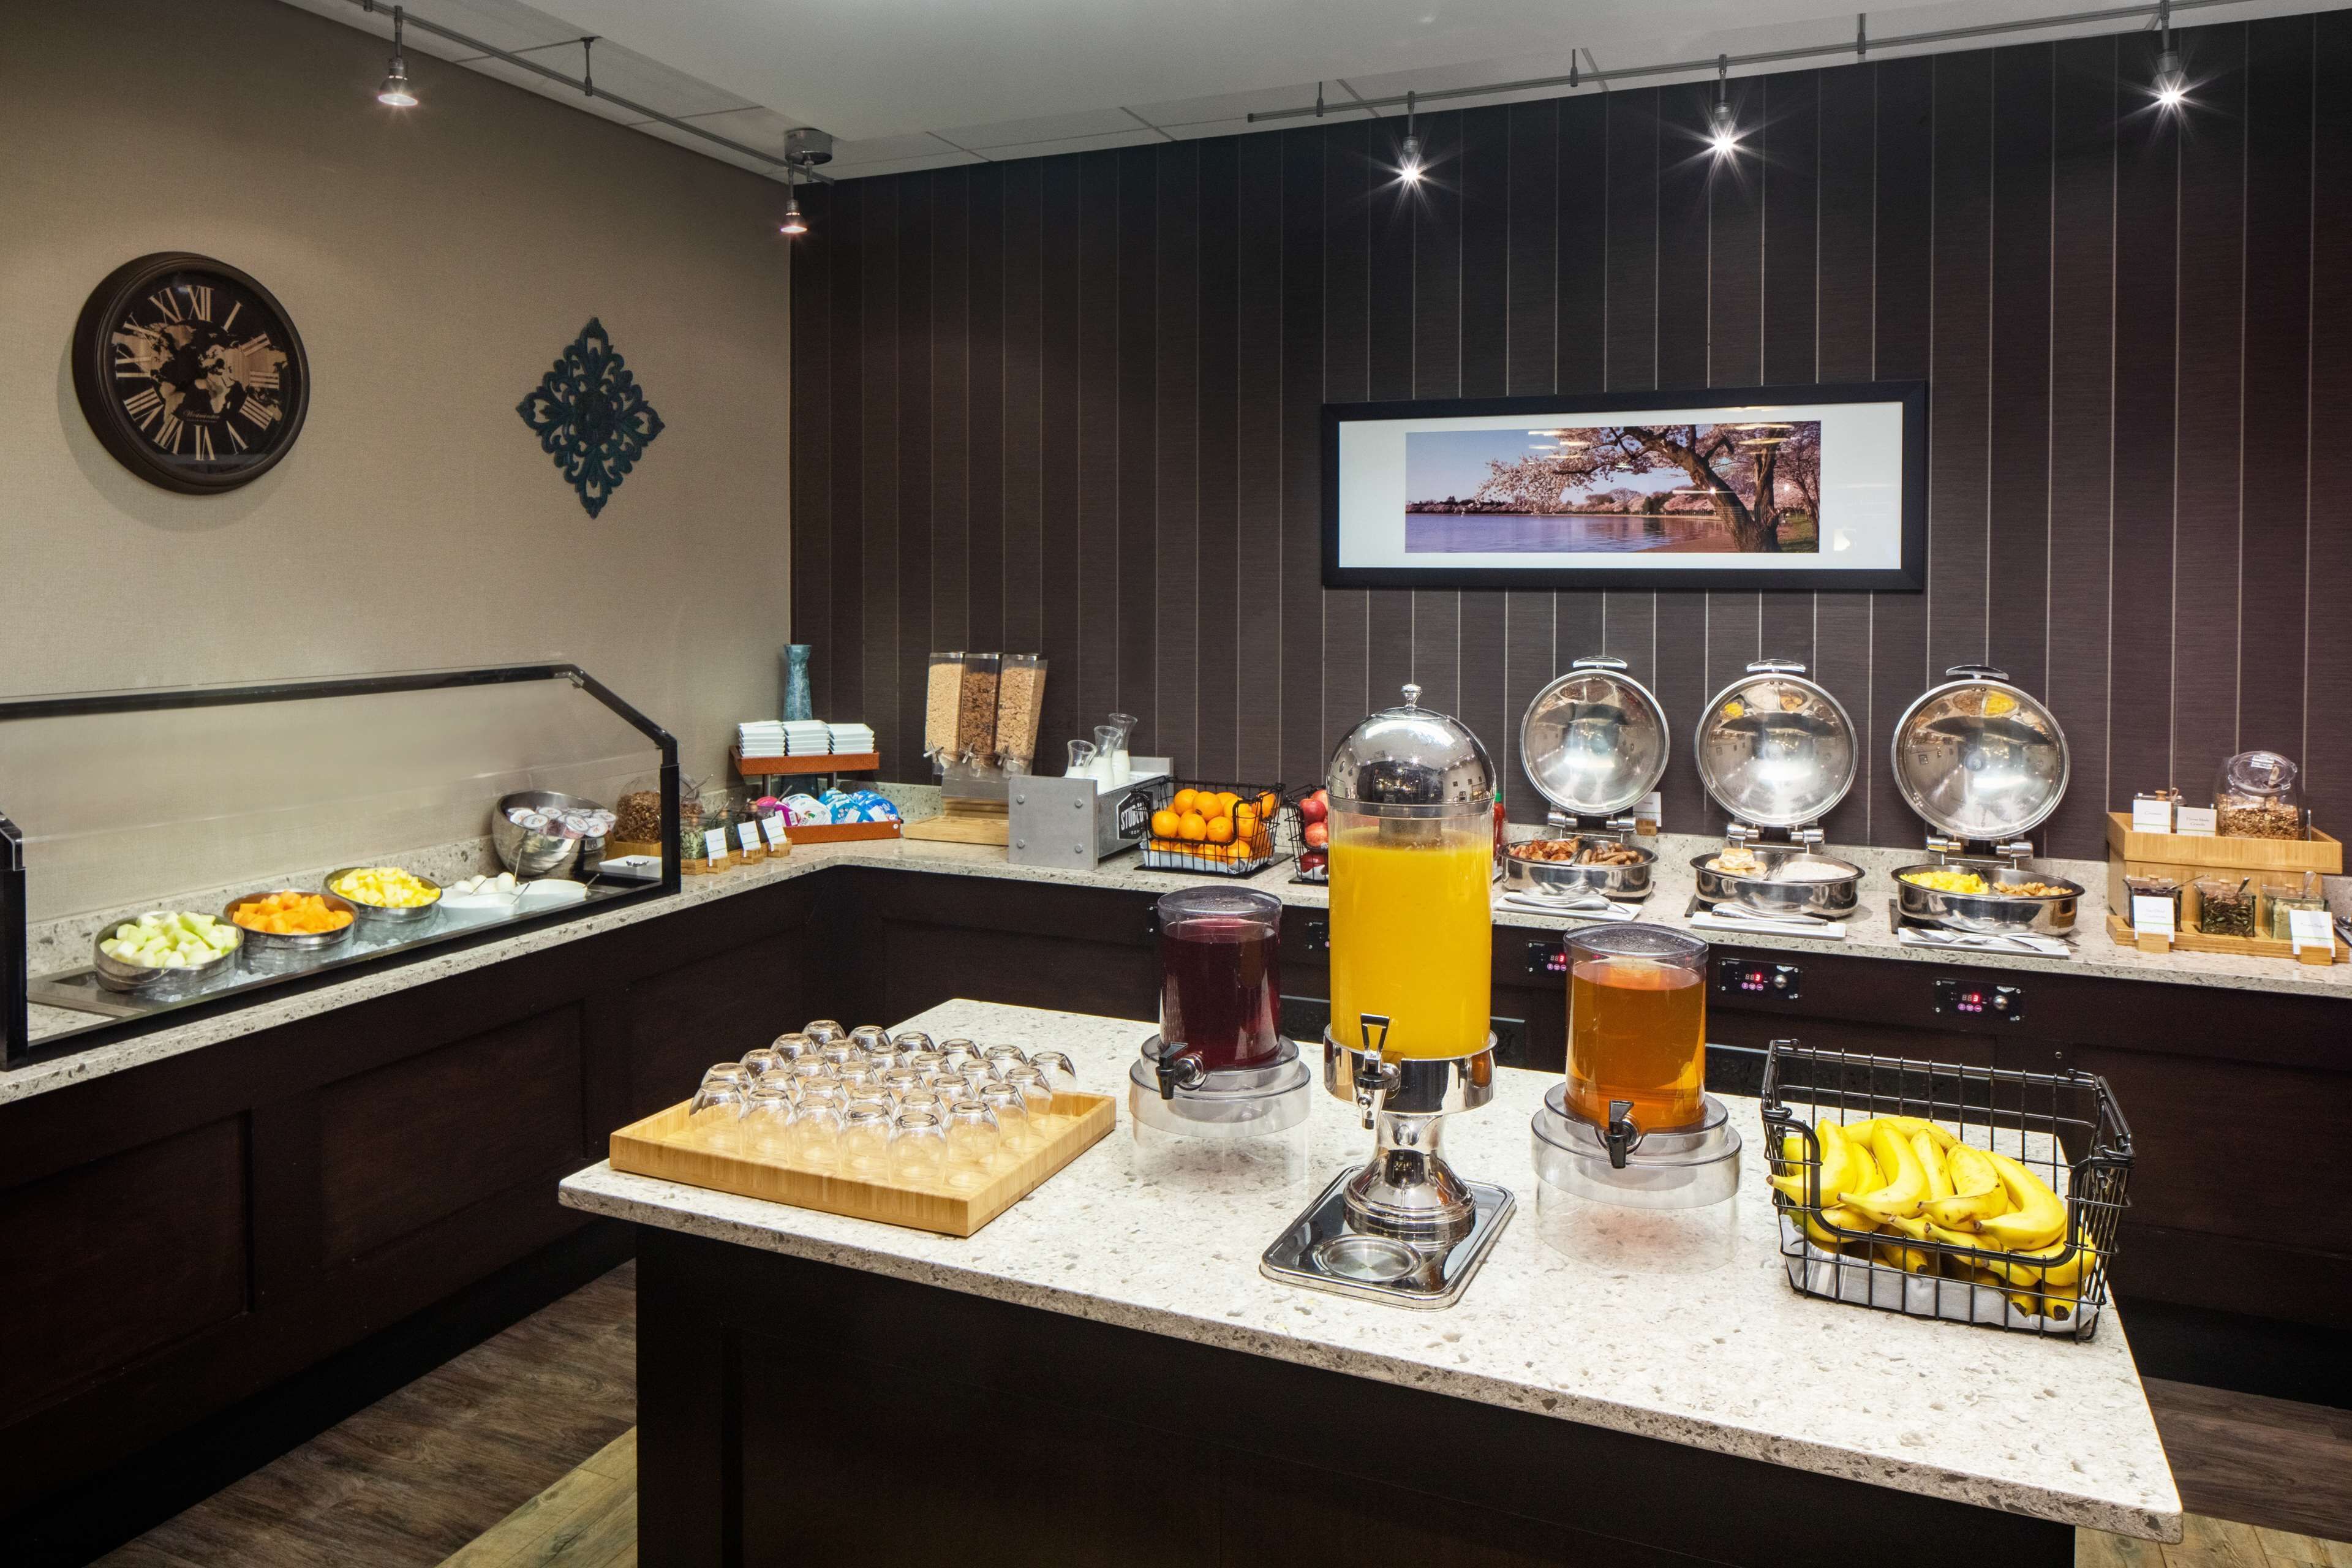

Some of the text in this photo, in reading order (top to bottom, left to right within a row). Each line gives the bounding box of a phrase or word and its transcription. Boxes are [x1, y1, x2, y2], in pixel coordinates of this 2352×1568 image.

[148, 287, 184, 325] XI
[186, 285, 213, 322] XII
[221, 300, 243, 333] I
[115, 345, 152, 380] IX
[239, 333, 271, 357] II
[249, 371, 280, 390] III
[123, 387, 165, 432] VIII
[153, 415, 184, 456] VII
[194, 424, 216, 461] VI
[226, 420, 249, 456] V
